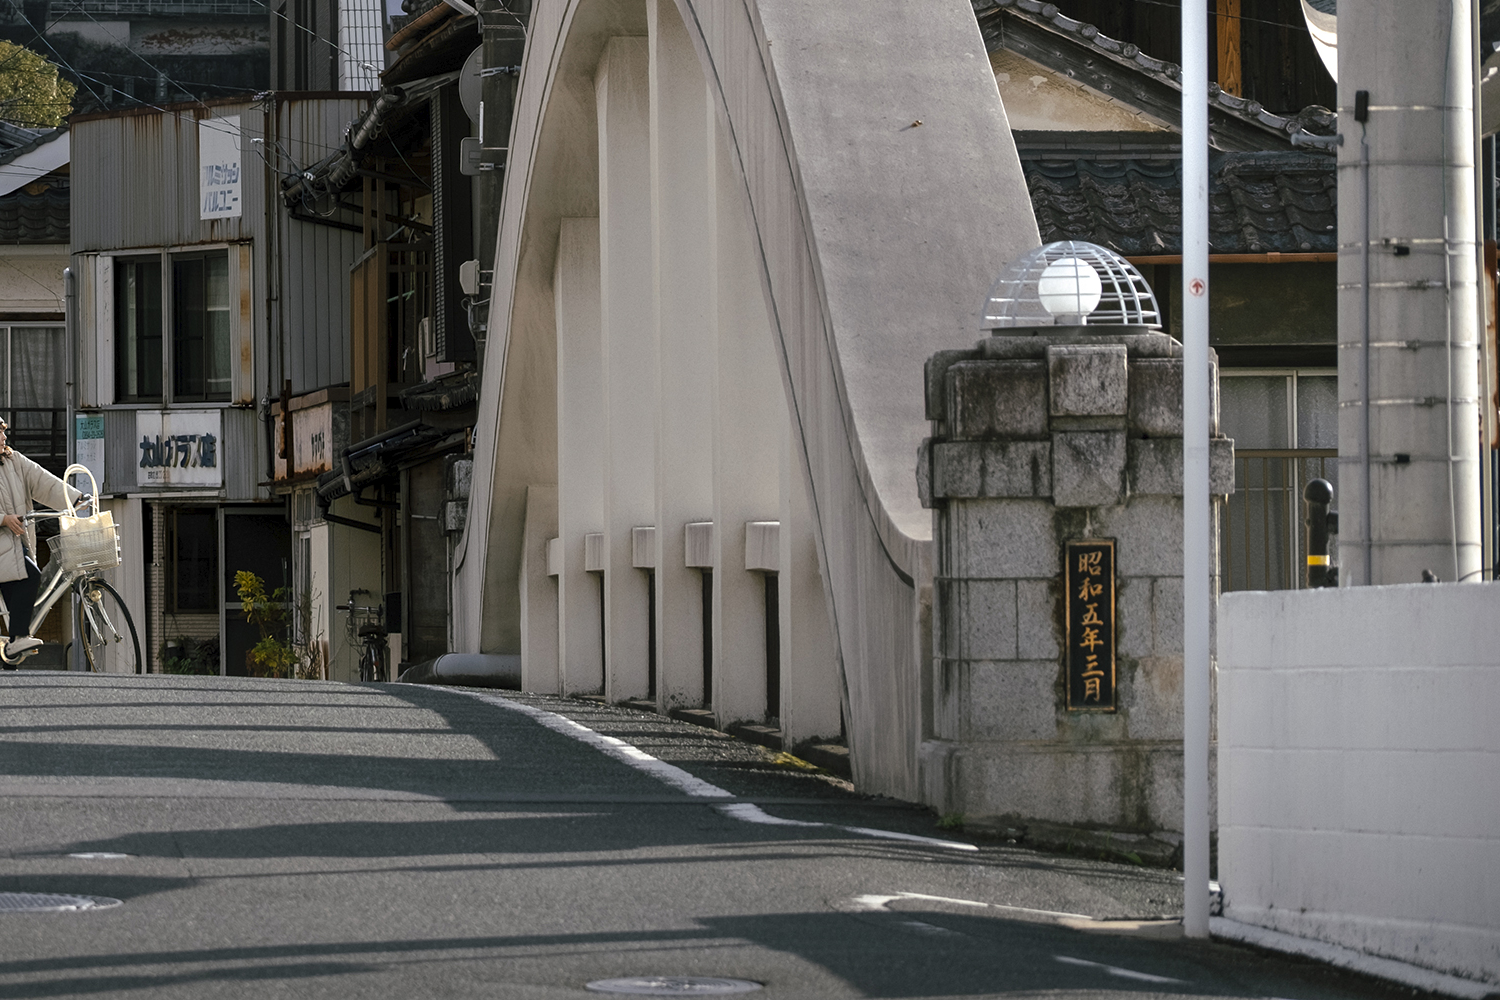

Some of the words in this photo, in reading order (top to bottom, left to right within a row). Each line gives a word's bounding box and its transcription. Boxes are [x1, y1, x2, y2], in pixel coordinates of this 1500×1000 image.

[1078, 550, 1105, 703] 昭和五年三月
